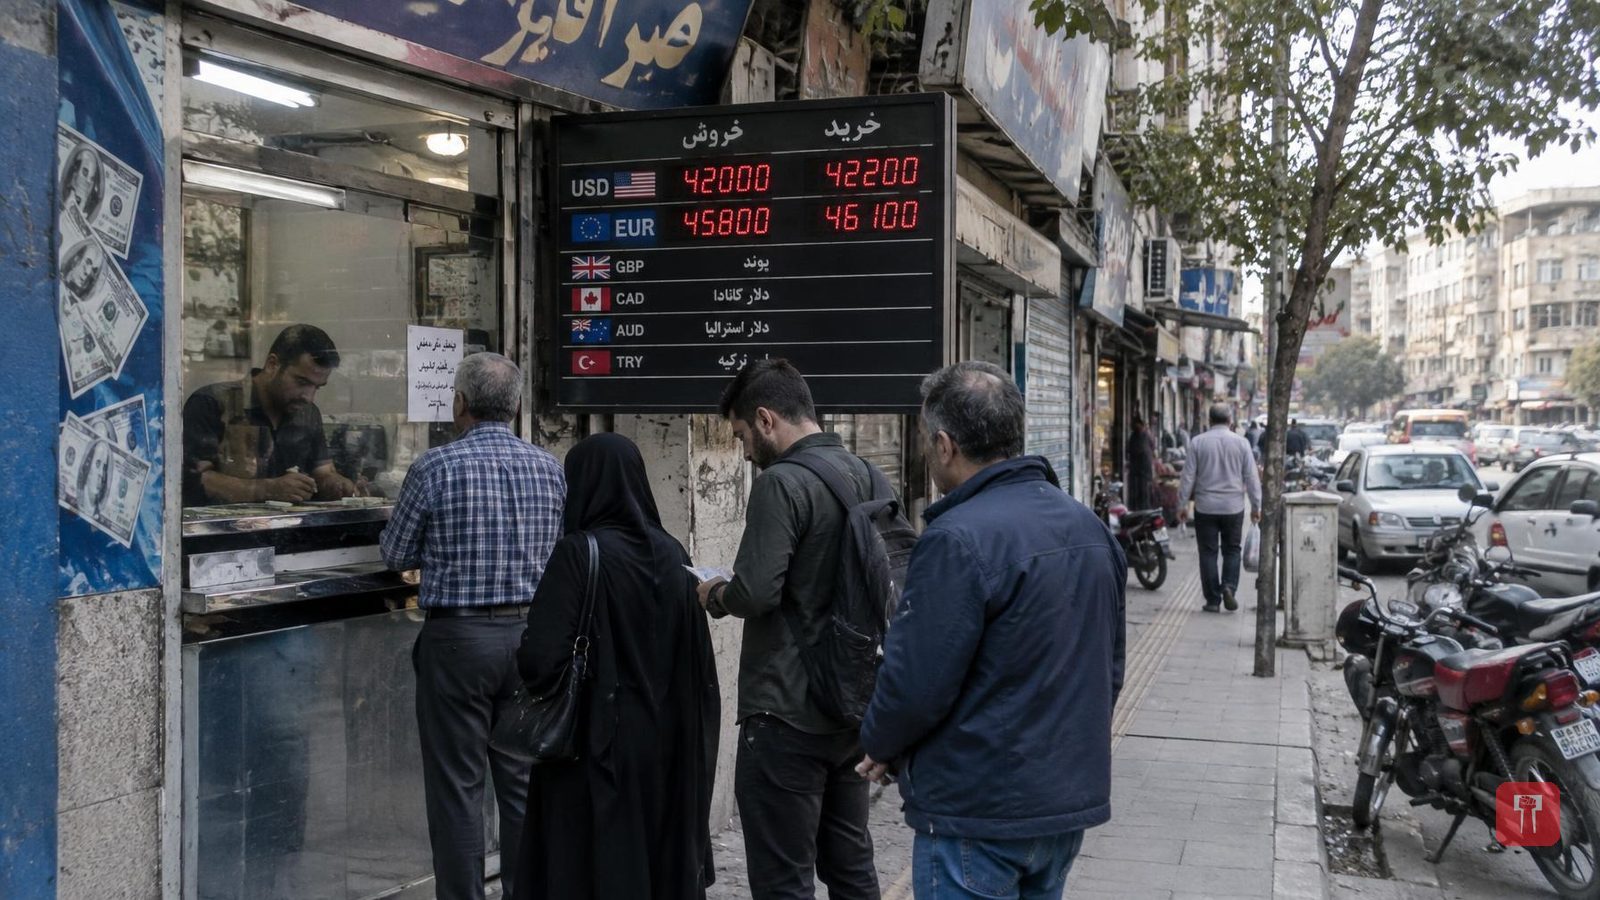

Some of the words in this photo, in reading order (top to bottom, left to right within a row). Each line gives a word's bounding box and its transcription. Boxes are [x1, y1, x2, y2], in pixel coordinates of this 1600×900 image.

[824, 111, 881, 141] خرید
[684, 164, 771, 193] 42000
[826, 157, 919, 187] 42200
[571, 179, 609, 197] USD
[615, 218, 655, 238] EUR
[684, 207, 770, 236] 45800
[615, 260, 645, 273] GBP
[616, 292, 645, 305] CAD
[713, 288, 744, 301] کانادا
[746, 287, 770, 305] دلار
[616, 324, 645, 337] AUD
[705, 321, 744, 338] استرالیا
[747, 321, 770, 337] دلار
[616, 356, 643, 368] TRY
